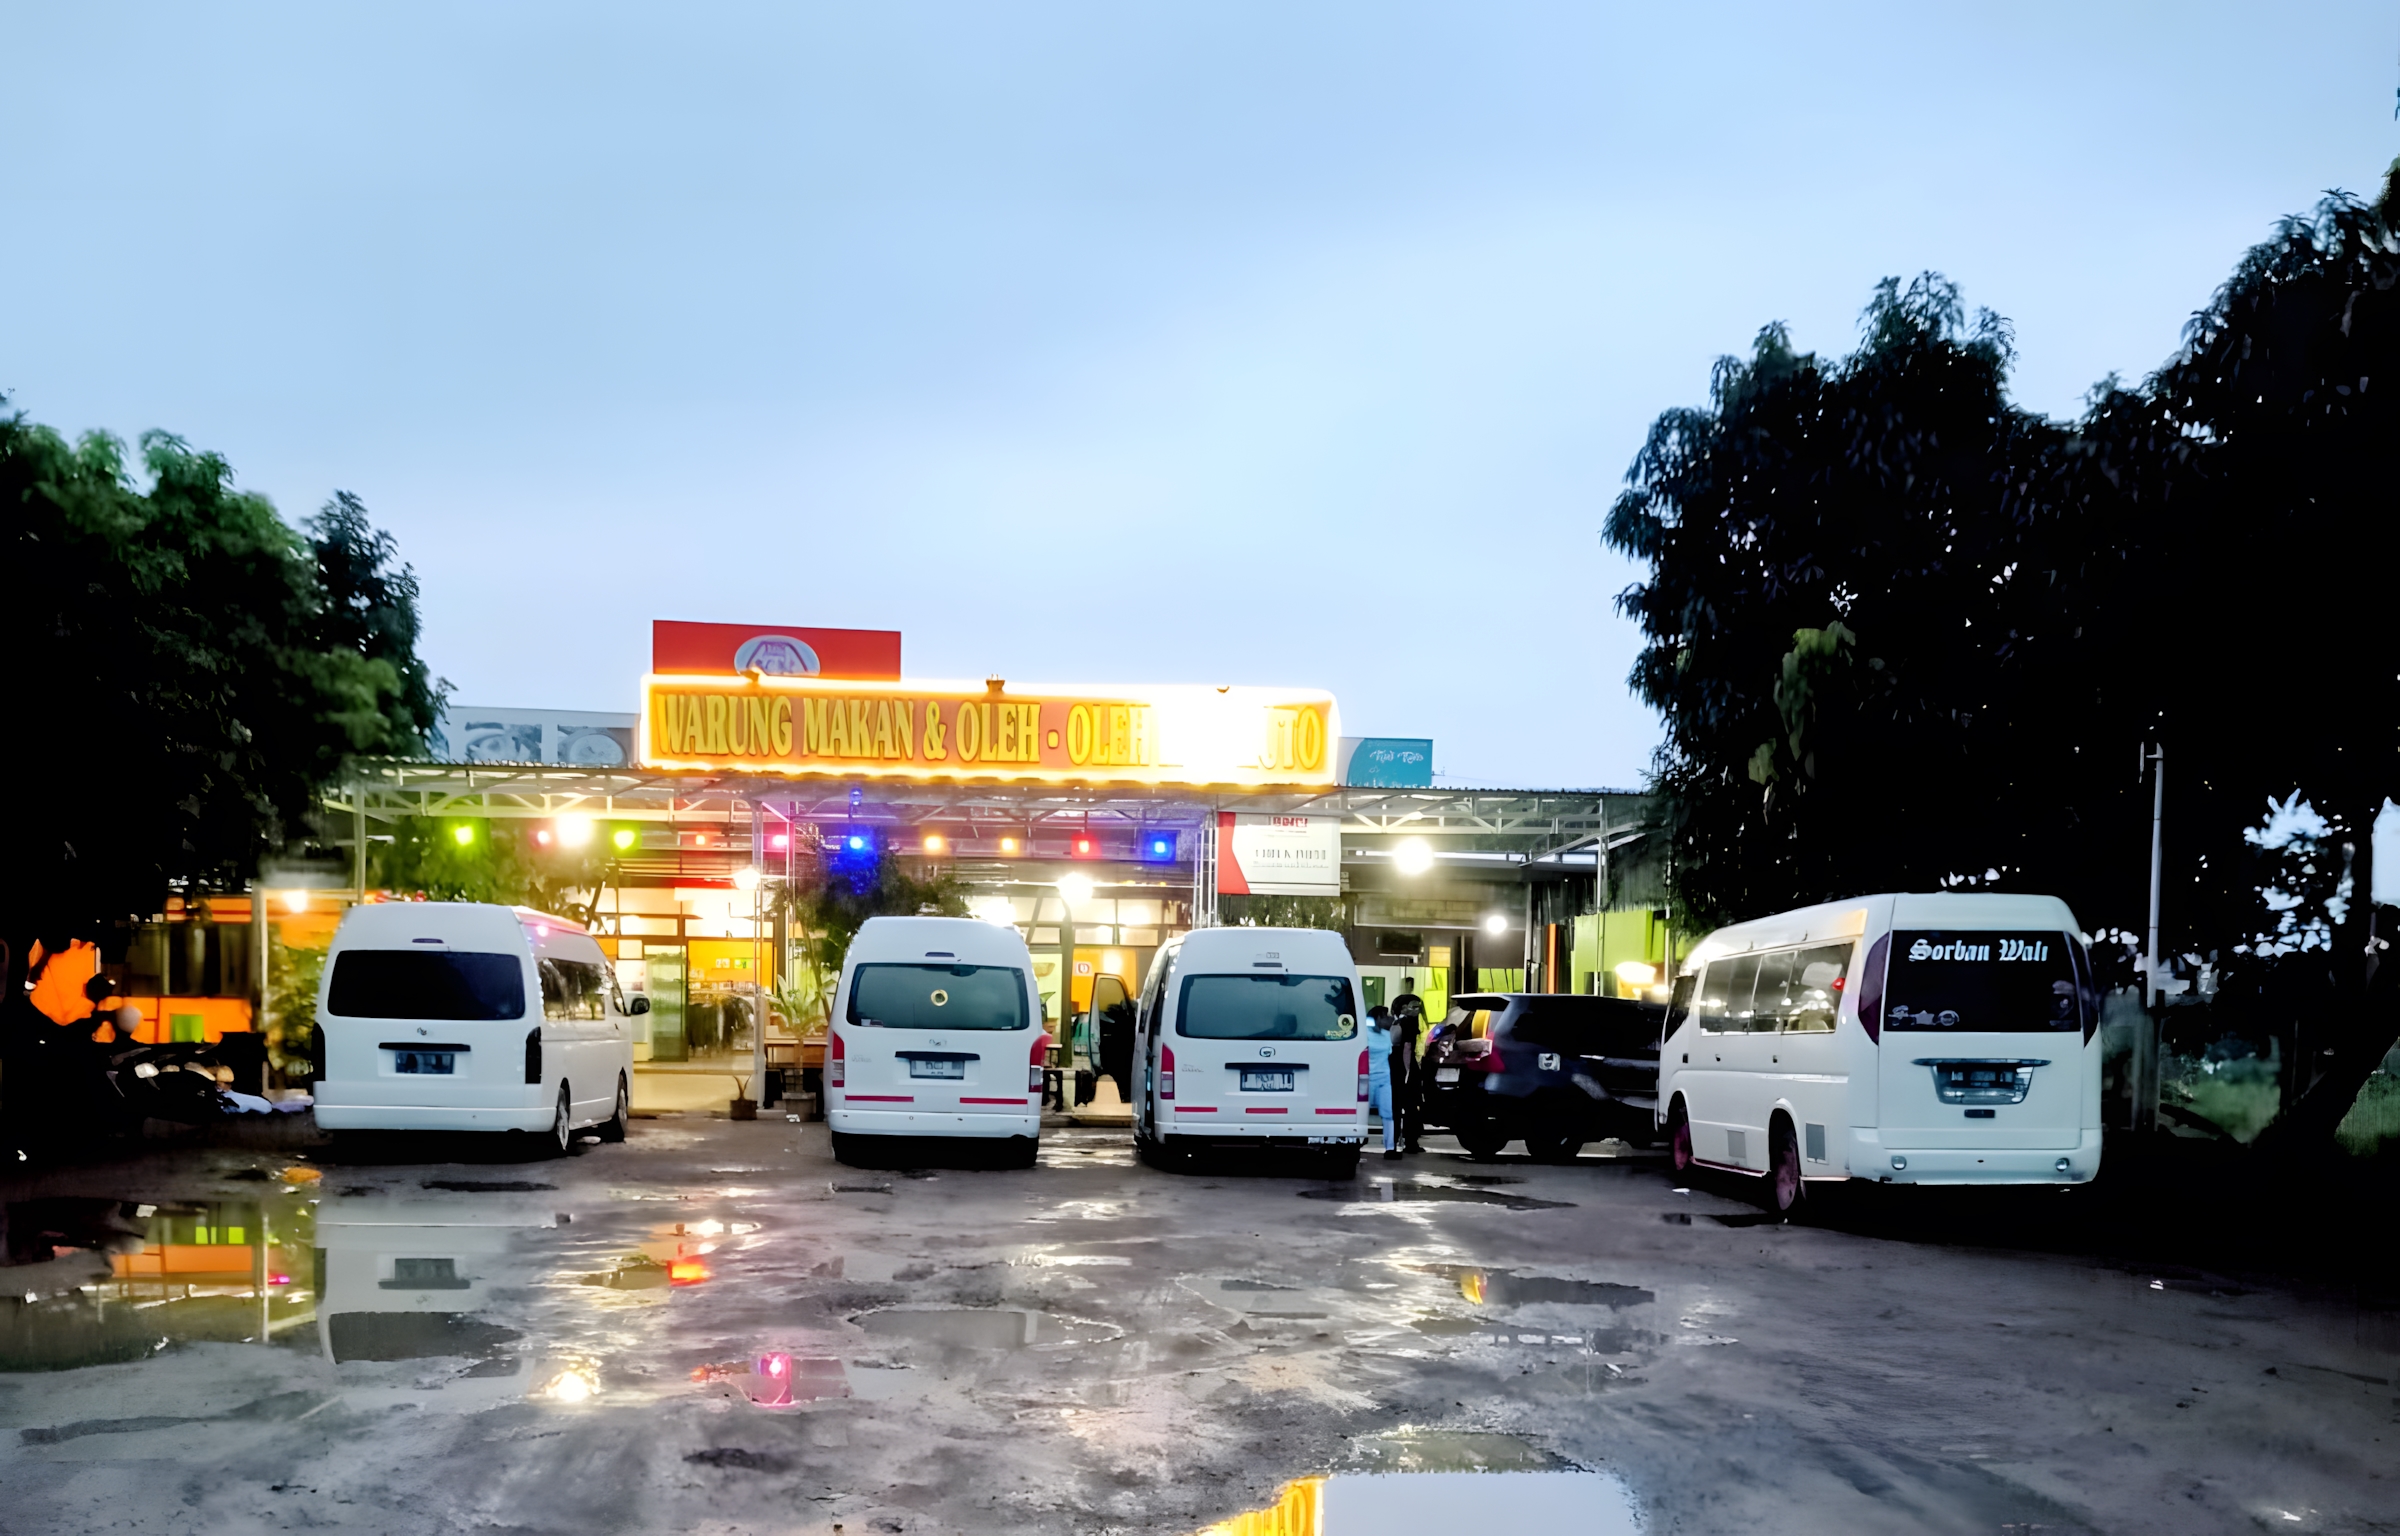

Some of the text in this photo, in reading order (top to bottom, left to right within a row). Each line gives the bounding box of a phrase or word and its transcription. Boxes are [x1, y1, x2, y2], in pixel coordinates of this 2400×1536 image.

[655, 693, 793, 757] WARUNG
[803, 697, 914, 760] MAKAN
[923, 701, 947, 760] &
[956, 701, 1041, 762] OLEH
[1066, 703, 1151, 767] OLEH
[1908, 938, 2048, 962] Sorban Wali
